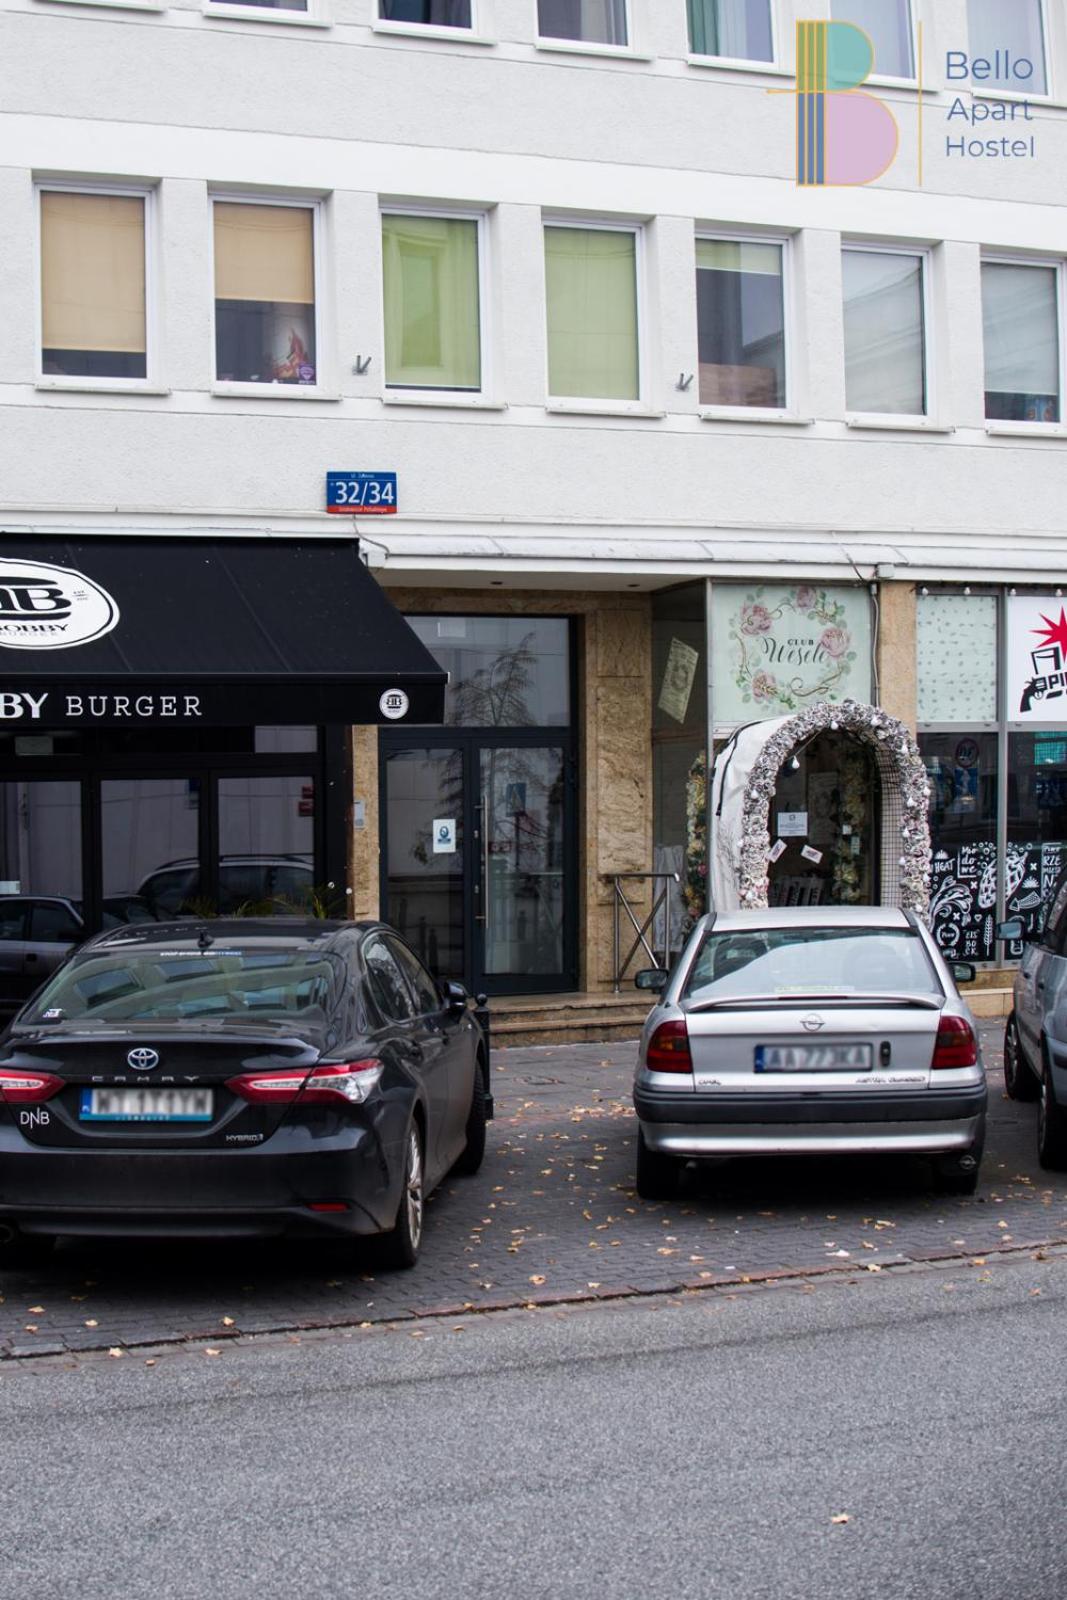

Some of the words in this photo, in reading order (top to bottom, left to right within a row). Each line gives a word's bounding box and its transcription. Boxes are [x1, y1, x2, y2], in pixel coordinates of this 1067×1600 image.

[335, 481, 394, 506] 32/34
[0, 624, 69, 632] OBBY
[65, 696, 202, 717] BURGER
[20, 1107, 50, 1129] DNB
